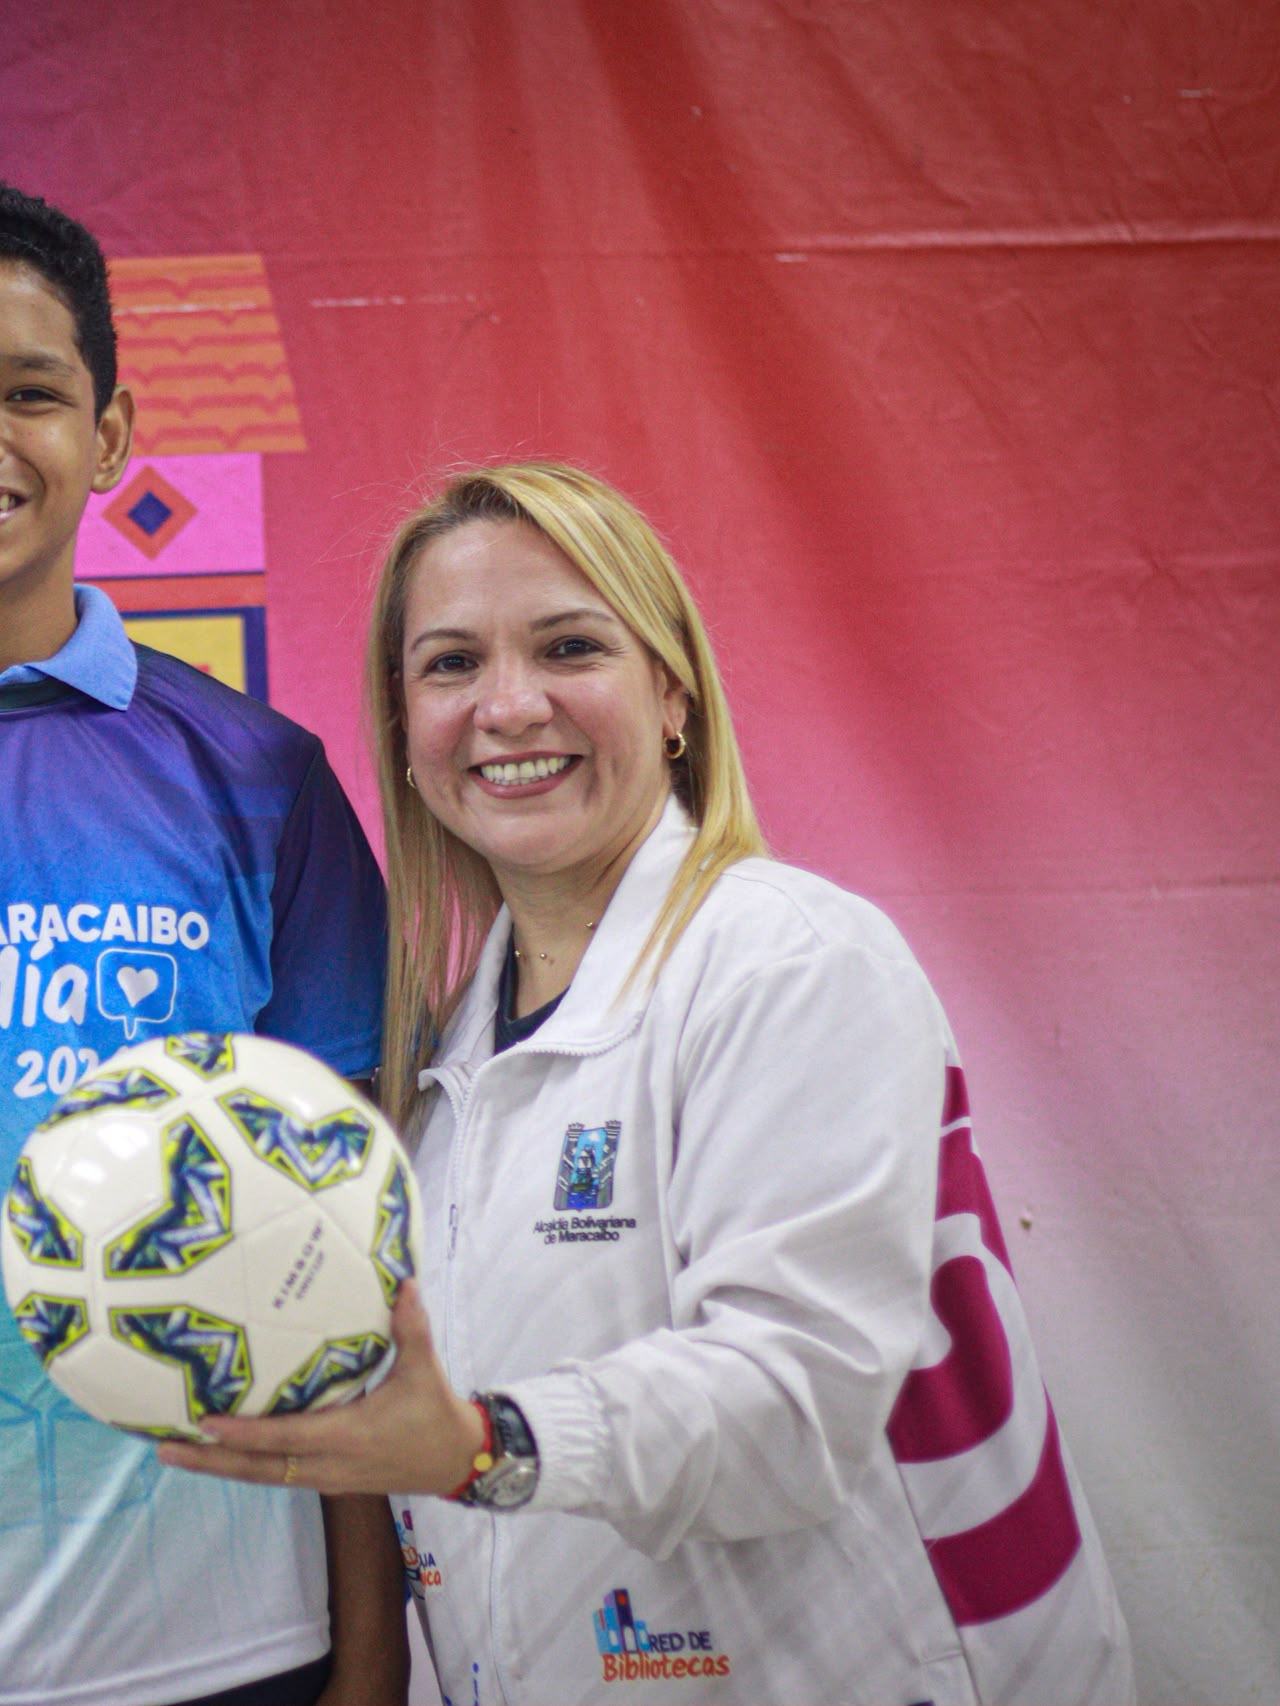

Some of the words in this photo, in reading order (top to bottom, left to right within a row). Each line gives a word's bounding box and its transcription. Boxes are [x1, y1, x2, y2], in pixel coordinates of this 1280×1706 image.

[13, 1045, 128, 1098] 202
[544, 1231, 557, 1245] de
[649, 1632, 685, 1653] RED
[687, 1631, 713, 1651] DE
[602, 1652, 730, 1682] Bibliotecas
